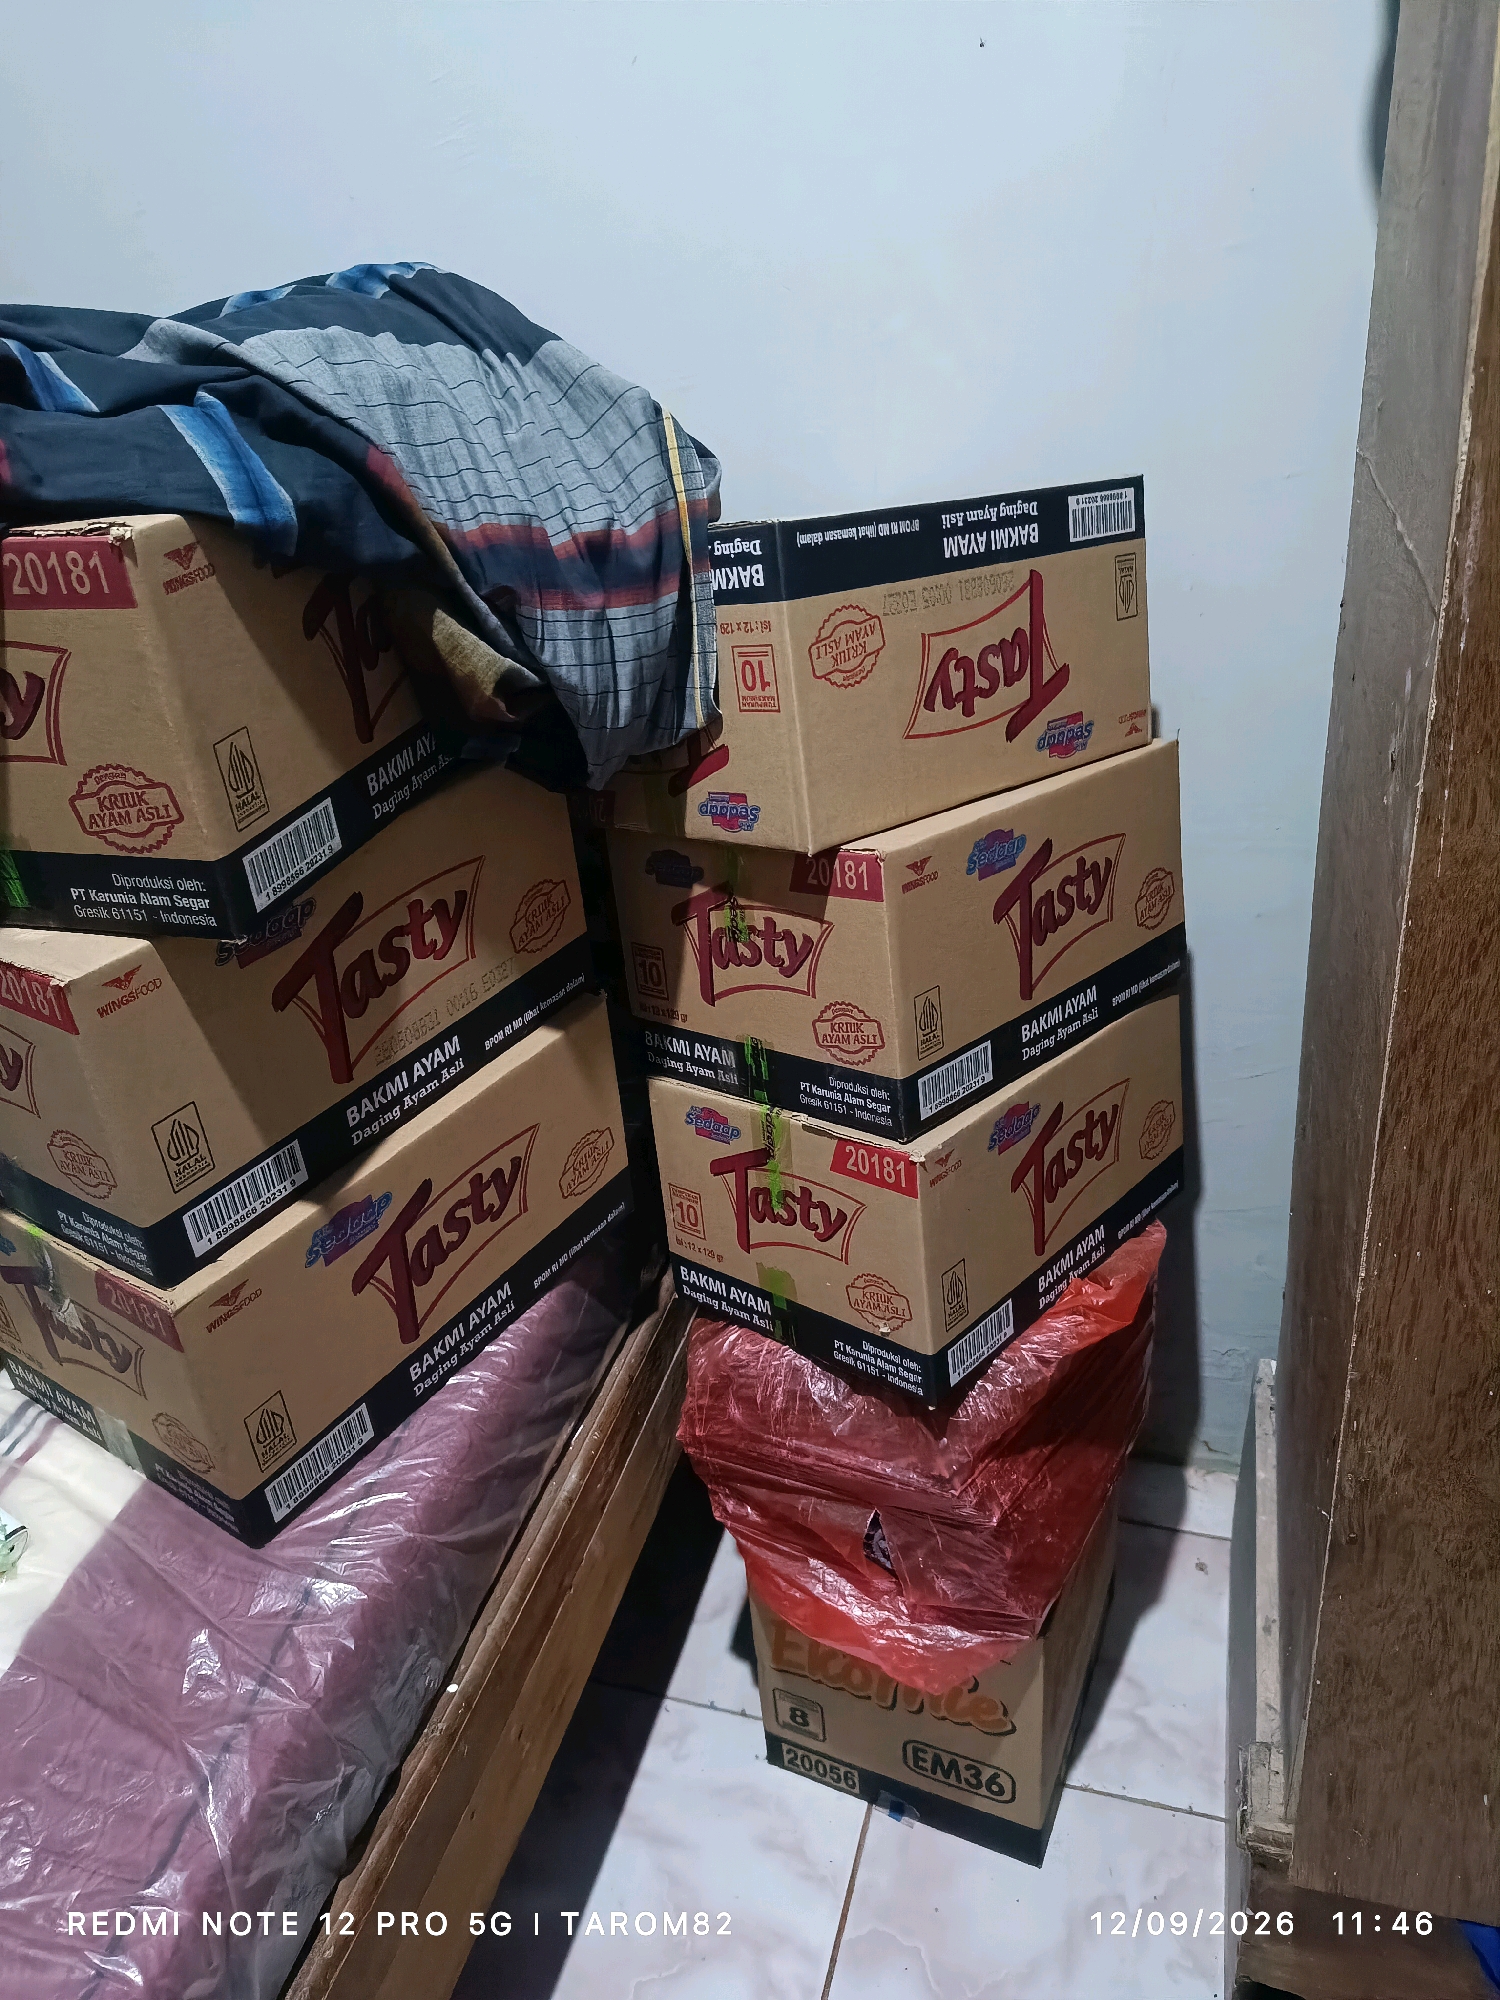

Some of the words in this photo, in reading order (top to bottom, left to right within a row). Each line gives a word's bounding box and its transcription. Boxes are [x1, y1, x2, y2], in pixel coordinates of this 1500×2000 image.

[899, 519, 920, 534] BPOM
[941, 508, 964, 529] Asli
[967, 505, 997, 522] Ayam
[1000, 501, 1038, 519] Daging
[797, 530, 824, 548] dalam)
[825, 527, 857, 542] kemasan
[858, 522, 877, 540] (lihat
[878, 523, 890, 536] MD
[943, 530, 987, 558] AYAM
[991, 523, 1039, 551] BAKMI
[714, 537, 762, 558] Daging
[3, 551, 110, 594] 20181
[710, 564, 764, 591] BAKM
[743, 621, 754, 634] 12
[844, 622, 876, 645] AYAM
[815, 639, 841, 660] ASLI
[831, 640, 867, 668] KRIUK
[923, 569, 1070, 743] Tasty
[740, 660, 771, 692] 10
[1036, 720, 1094, 752] Sedaap
[366, 746, 415, 796] BAKMI
[416, 731, 437, 761] AY
[97, 791, 149, 813] KRIUK
[372, 785, 410, 820] Daging
[411, 764, 438, 791] Ayam
[88, 812, 132, 829] AYAM
[137, 804, 172, 821] ASLI
[698, 797, 761, 823] Sedaap
[111, 873, 174, 889] Diproduksi
[176, 879, 207, 892] oleh:
[805, 858, 868, 891] 20181
[70, 887, 86, 901] PT
[89, 889, 137, 905] Karunia
[140, 892, 172, 907] Alam
[174, 896, 210, 911] Segar
[74, 904, 110, 919] Gresik
[111, 907, 148, 922] 61151
[159, 912, 217, 927] Indonesia
[993, 837, 1112, 1000] Tasty
[671, 881, 814, 1007] Tasty
[271, 889, 468, 1084] Tasty
[639, 959, 662, 988] 10
[96, 978, 163, 1018] WINGSFOOD
[1021, 1005, 1063, 1043] BAKMI
[1064, 984, 1097, 1019] AYAM
[484, 1030, 504, 1050] BPOM
[504, 1024, 512, 1036] RI
[513, 1017, 522, 1031] MD
[821, 1034, 851, 1046] AYAM
[853, 1034, 878, 1045] ASLI
[830, 1022, 864, 1034] KRIUK
[1021, 1035, 1056, 1060] Daging
[1056, 1020, 1081, 1040] Ayam
[1082, 1007, 1099, 1025] Asli
[645, 1031, 691, 1057] BAKMI
[694, 1042, 736, 1069] AYAM
[346, 1071, 409, 1128] BAKMI
[413, 1035, 460, 1083] AYAM
[647, 1052, 684, 1073] Daging
[686, 1062, 716, 1079] Ayam
[717, 1070, 738, 1085] Asli
[351, 1105, 401, 1146] Daging
[403, 1080, 439, 1110] Ayam
[441, 1058, 465, 1083] Asli
[800, 1081, 810, 1092] PT
[811, 1084, 842, 1101] Karunia
[844, 1094, 864, 1107] Alam
[866, 1100, 891, 1114] Segar
[828, 1077, 869, 1096] Diproduksi
[870, 1088, 890, 1101] oleh:
[962, 1079, 980, 1095] 20231
[685, 1112, 741, 1141] Sedaap
[800, 1094, 822, 1108] Gresik
[824, 1101, 847, 1114] 61151
[854, 1108, 893, 1127] Indonesia
[174, 1154, 206, 1177] HALAL
[845, 1145, 906, 1188] 20181
[1011, 1100, 1119, 1257] Tasty
[216, 1208, 257, 1241] 8998866
[260, 1184, 288, 1209] 20231
[290, 1179, 297, 1188] 9
[676, 1201, 699, 1228] 10
[709, 1147, 847, 1254] Tasty
[351, 1156, 522, 1344] Tasty
[687, 1242, 696, 1251] 12
[1038, 1250, 1074, 1293] BAKMI
[1076, 1224, 1105, 1261] AYAM
[680, 1265, 727, 1297] BAKMI
[729, 1286, 772, 1316] AYAM
[1039, 1280, 1068, 1310] Daging
[1069, 1263, 1091, 1282] Ayam
[1091, 1244, 1106, 1264] Asli
[104, 1283, 166, 1336] 20181
[205, 1287, 262, 1334] WINGSFOOD
[683, 1284, 719, 1310] Daging
[721, 1300, 751, 1321] Ayam
[753, 1313, 774, 1332] Asli
[853, 1298, 881, 1312] AYAM
[882, 1303, 906, 1317] ASLI
[862, 1291, 894, 1305] KRIUK
[409, 1323, 465, 1381] BAKMI
[469, 1281, 512, 1331] AYAM
[414, 1353, 457, 1397] Daging
[460, 1323, 492, 1356] Ayam
[494, 1300, 515, 1326] Asli
[834, 1339, 844, 1352] PT
[845, 1344, 876, 1364] Karunia
[877, 1358, 897, 1374] Alam
[898, 1367, 922, 1384] Segar
[862, 1340, 901, 1365] Diproduksi
[902, 1359, 922, 1373] oleh:
[833, 1350, 856, 1367] Gresik
[857, 1361, 880, 1377] 61151
[887, 1373, 924, 1397] Indonesia
[7, 1358, 53, 1398] BAKMI
[55, 1390, 95, 1425] AYAM
[789, 1706, 809, 1727] 8
[785, 1749, 858, 1791] 20056
[911, 1745, 1006, 1797] EM36
